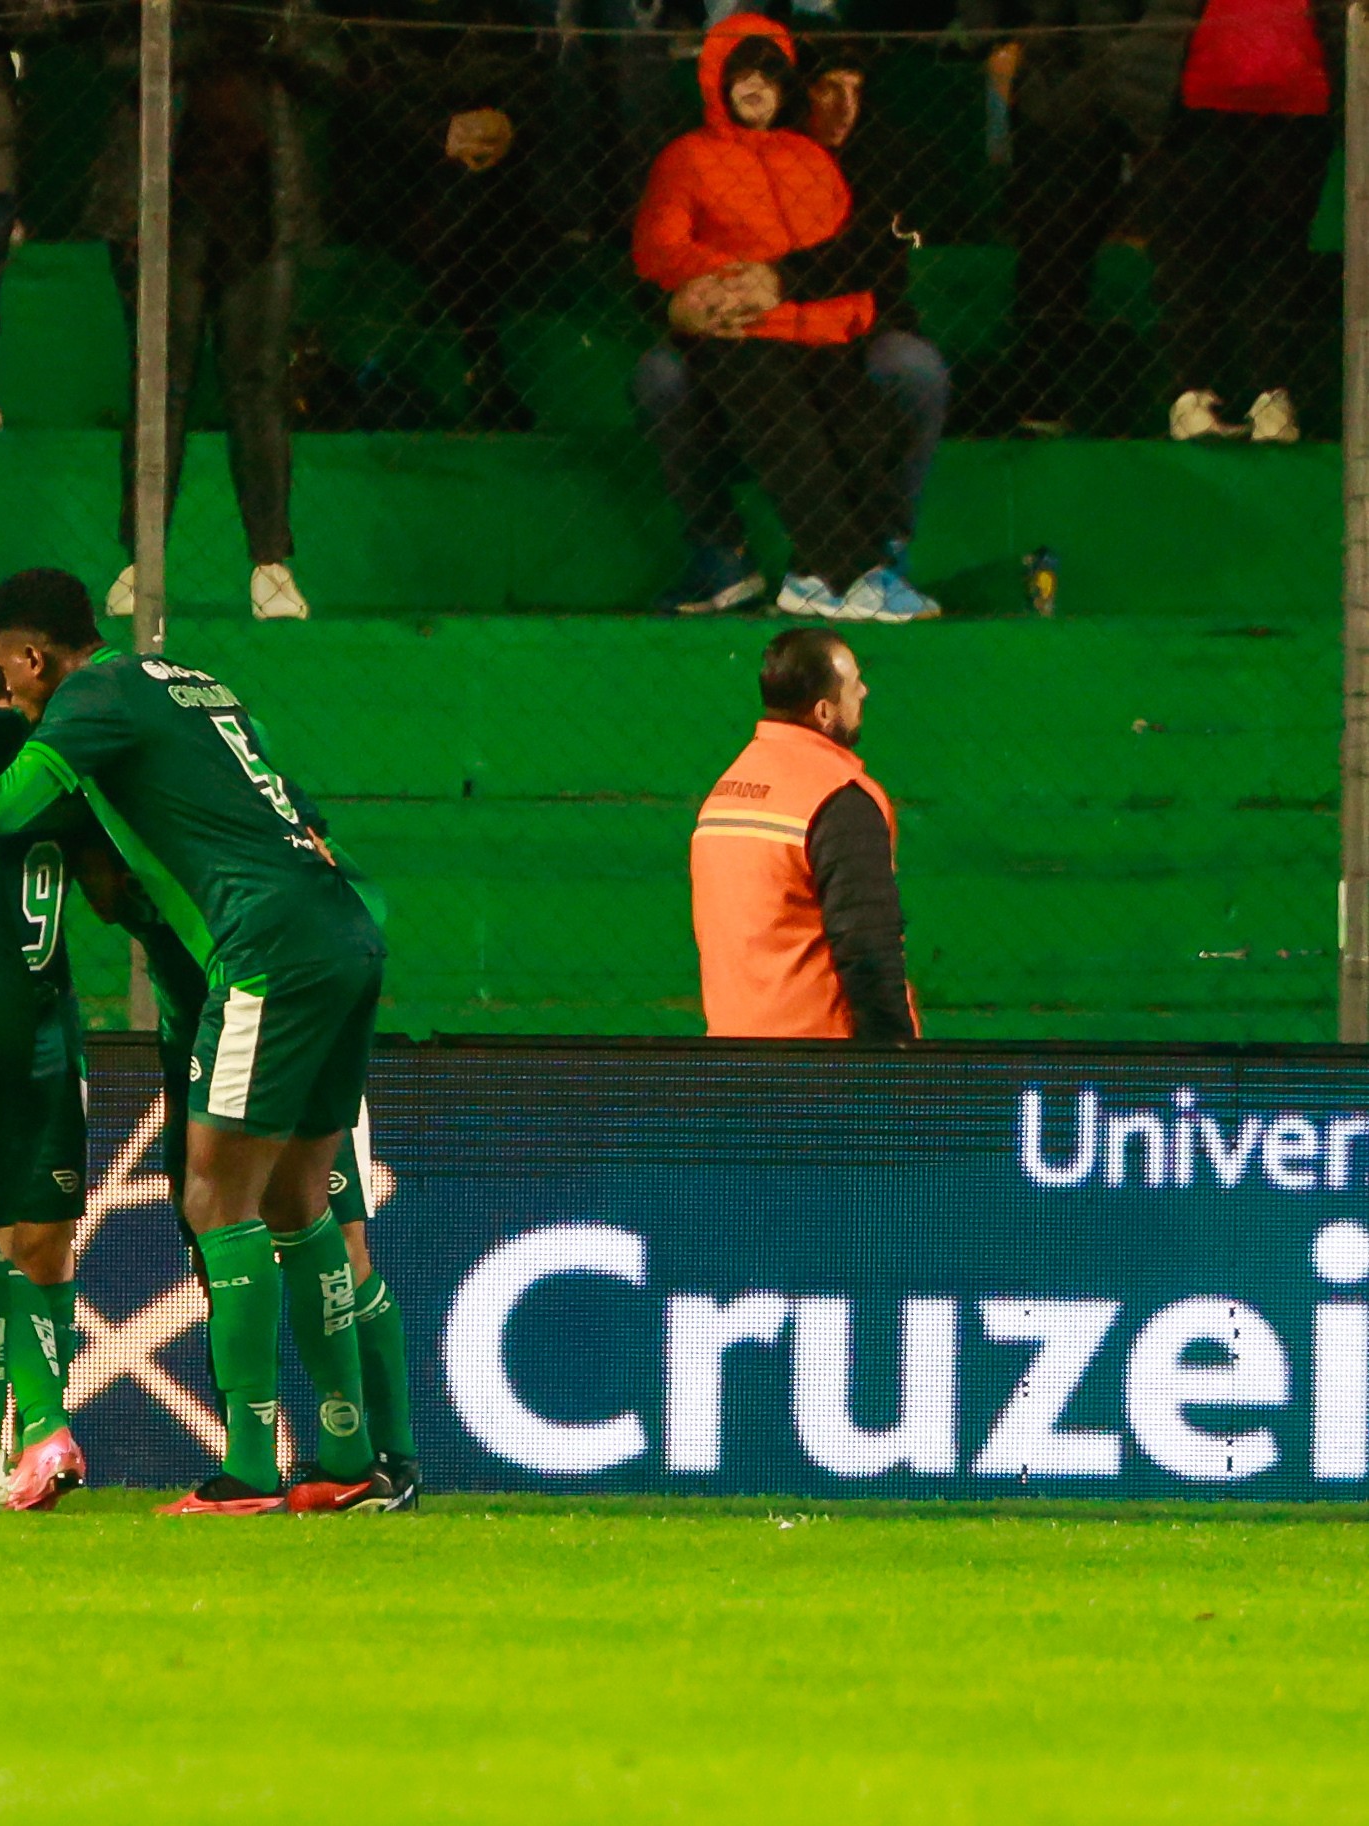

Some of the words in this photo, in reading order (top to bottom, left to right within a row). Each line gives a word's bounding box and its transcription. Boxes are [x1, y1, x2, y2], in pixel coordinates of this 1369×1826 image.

[210, 715, 299, 824] 5
[21, 841, 63, 971] 9
[1019, 1086, 1369, 1190] Univer
[441, 1219, 1369, 1479] Cruzei
